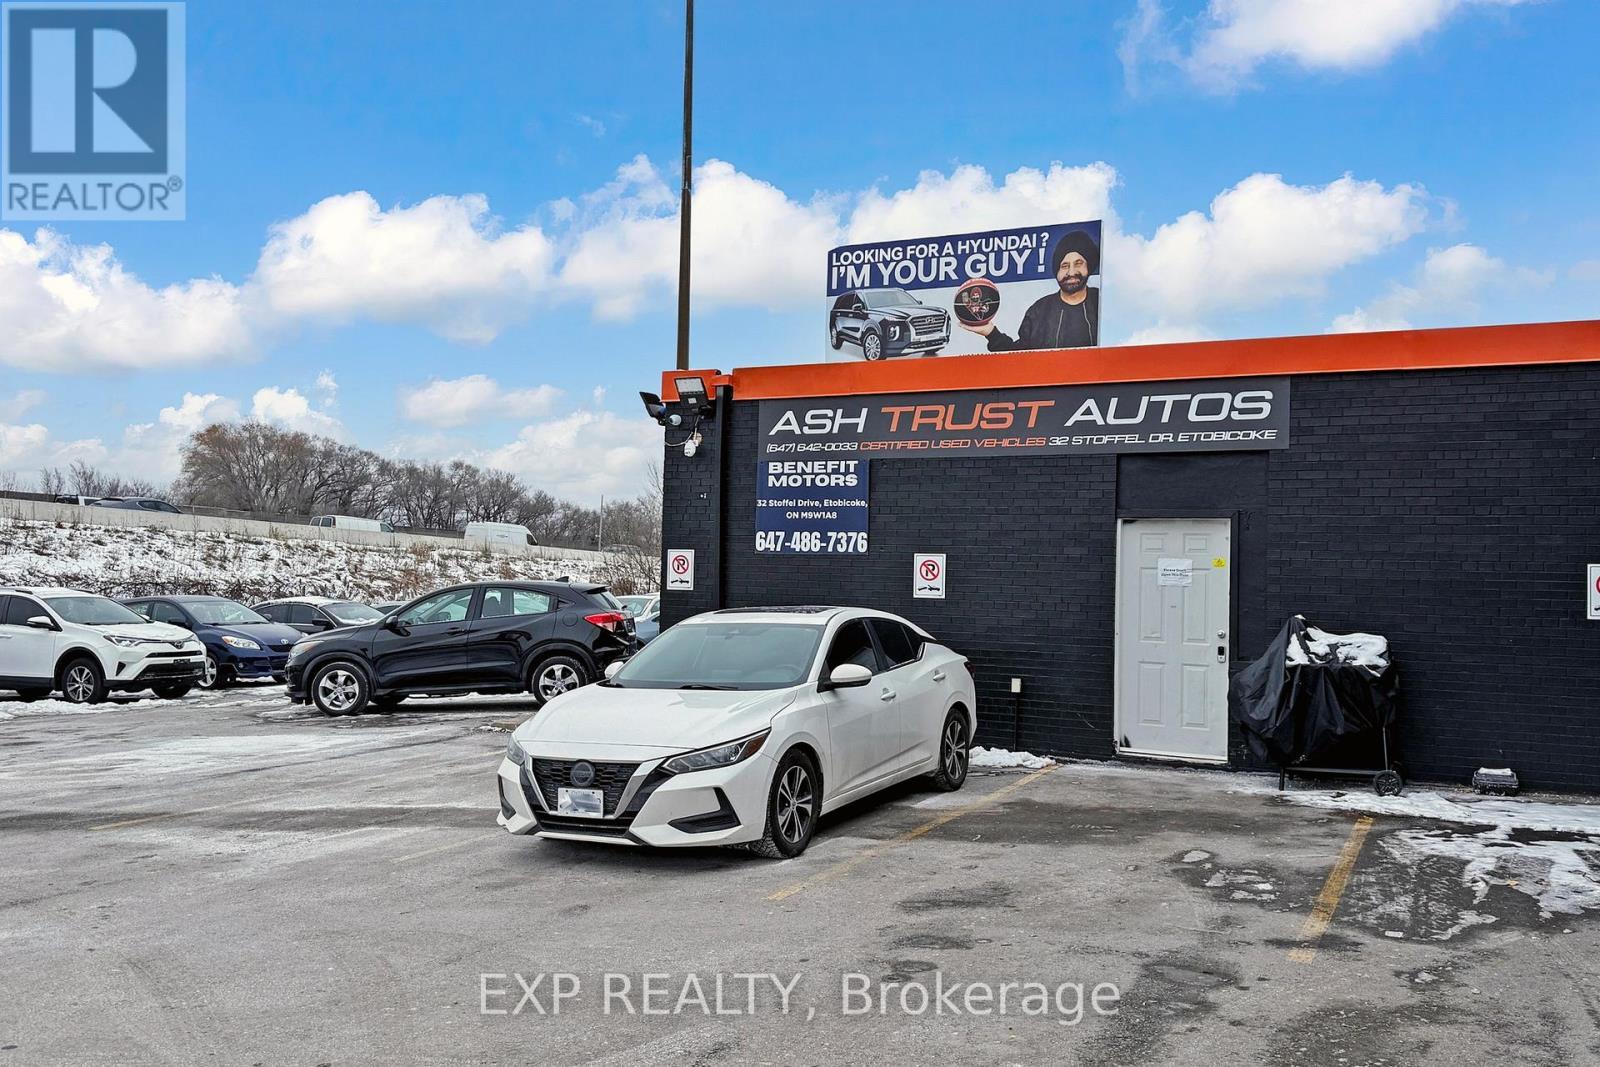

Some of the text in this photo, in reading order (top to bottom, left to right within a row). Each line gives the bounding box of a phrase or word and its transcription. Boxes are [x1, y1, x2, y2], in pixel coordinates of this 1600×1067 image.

[832, 250, 904, 265] LOOKING
[906, 244, 939, 258] FOR
[941, 243, 955, 257] A
[958, 233, 1038, 251] HYUNDAI
[874, 256, 958, 286] YOUR
[964, 250, 1033, 279] GUY
[768, 390, 1273, 436] ASH TRUST AUTOS
[766, 443, 796, 453] (647)
[797, 442, 858, 453] 642-0033
[859, 440, 928, 451] CERTIFIED
[931, 439, 970, 449] USED
[974, 437, 1046, 448] VEHICLES
[1048, 436, 1069, 446] 32
[1071, 434, 1145, 446] STOFFEL
[1177, 429, 1278, 442] ETOBICOKE
[768, 460, 859, 474] BENEFIT
[767, 474, 858, 487] MOTORS
[756, 499, 869, 508] 32 Stoffel Drive, Etobicoke,
[786, 511, 838, 519] ON M9W1A8
[755, 531, 868, 553] 647-486-7376
